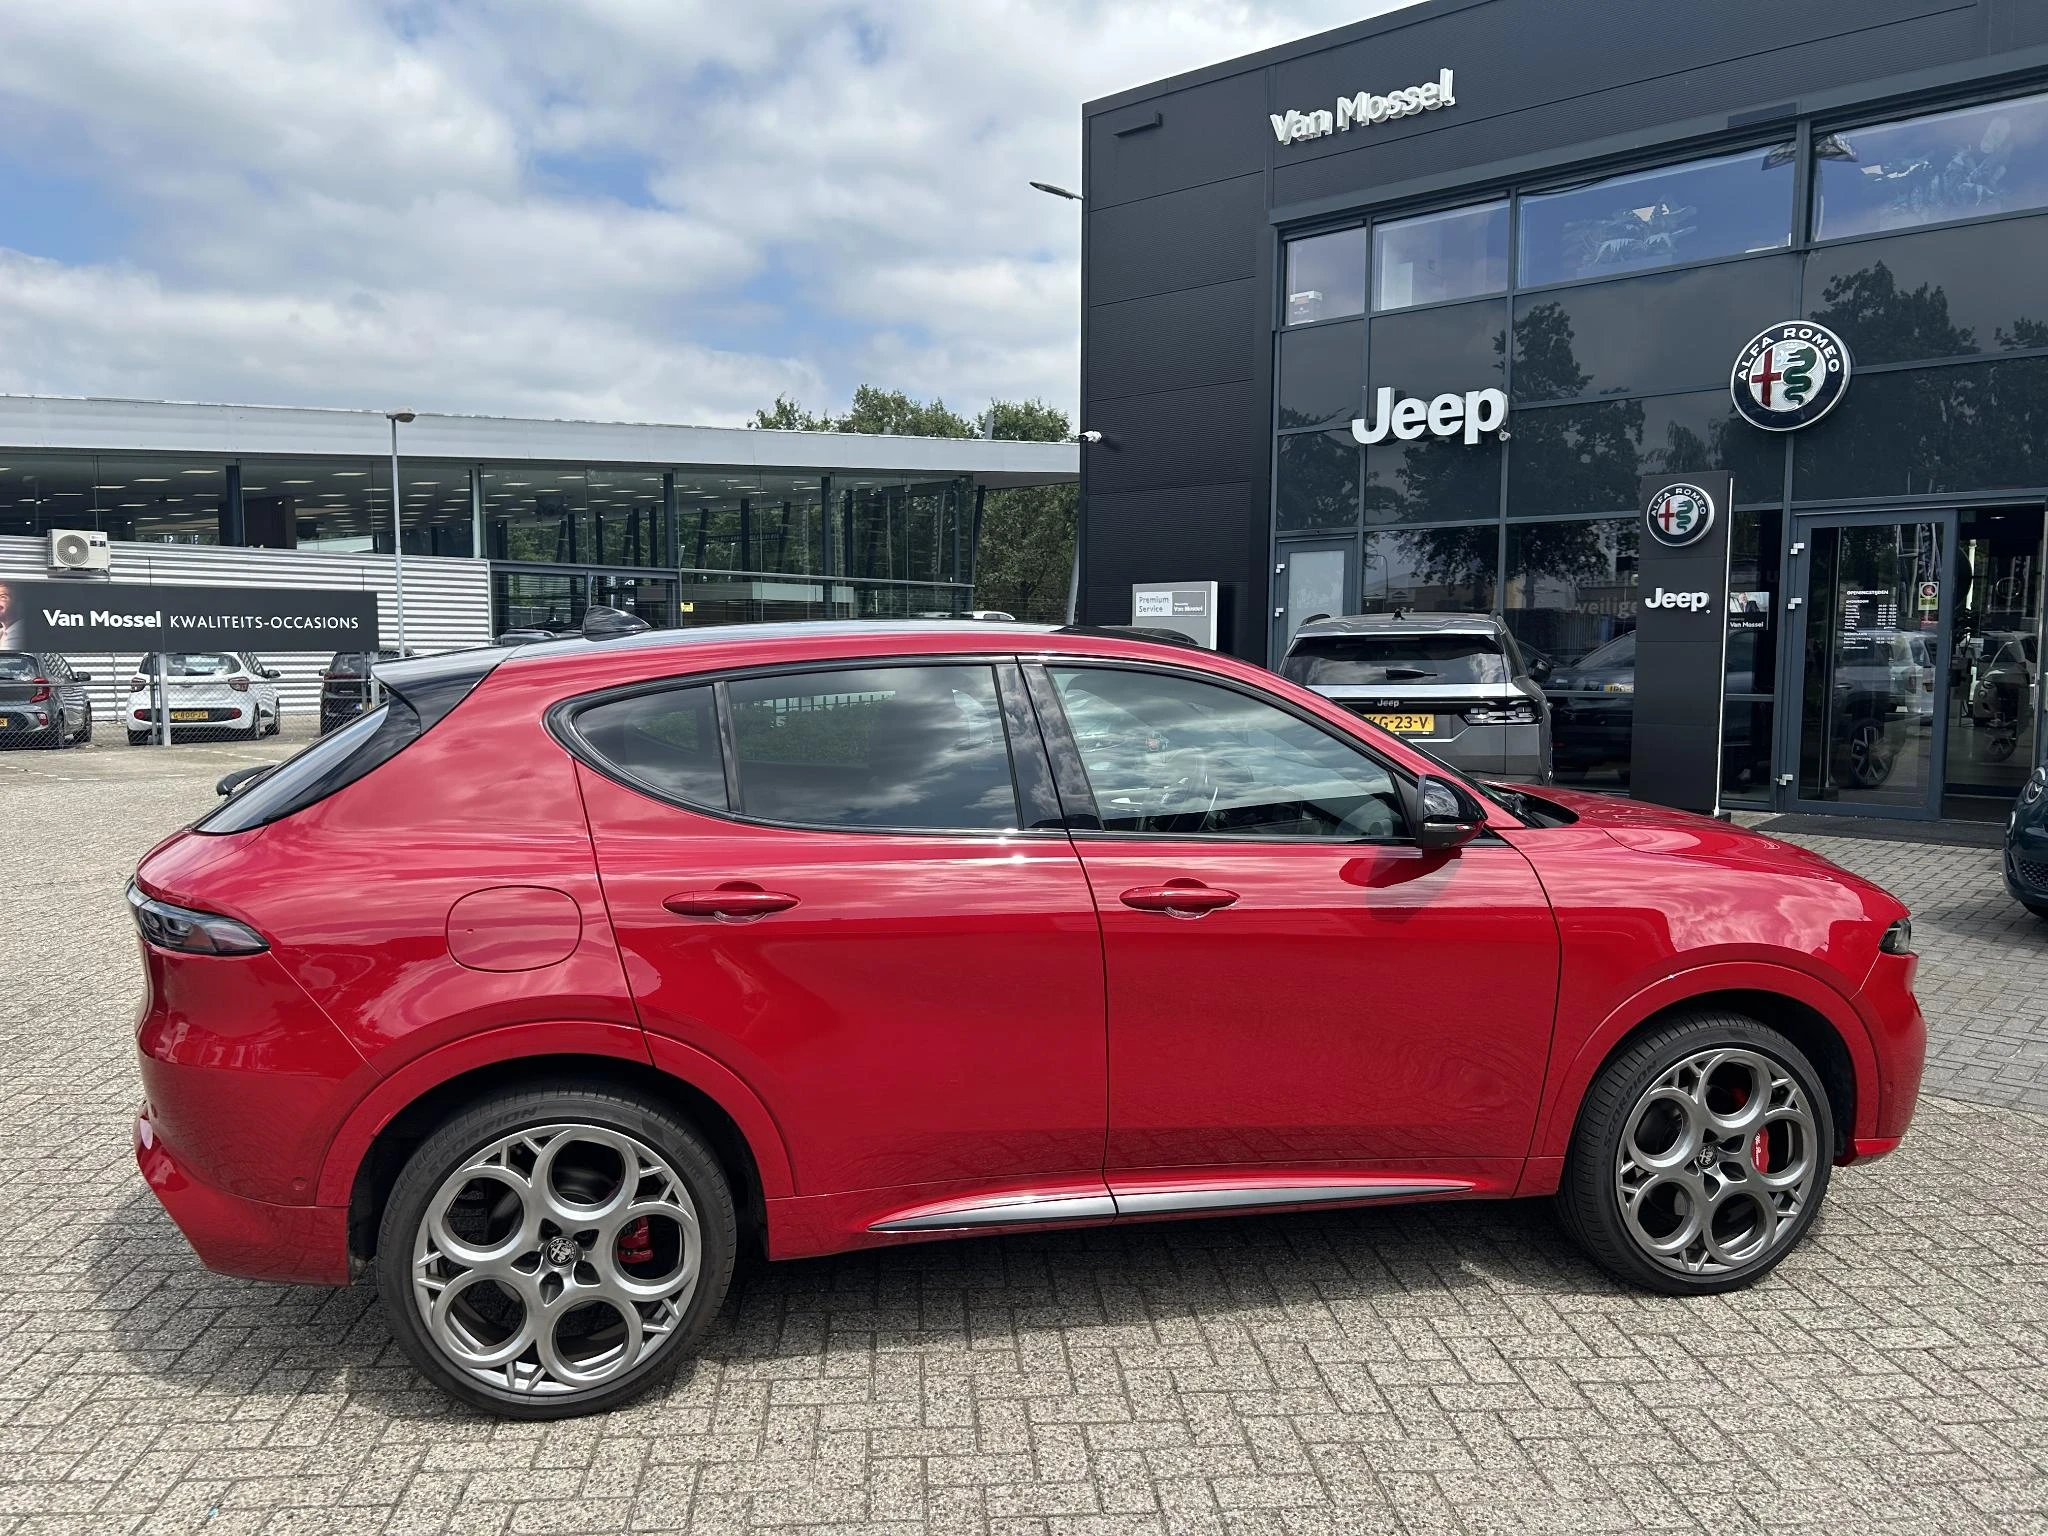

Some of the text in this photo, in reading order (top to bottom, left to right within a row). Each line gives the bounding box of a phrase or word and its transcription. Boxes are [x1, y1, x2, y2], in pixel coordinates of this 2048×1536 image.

[1270, 67, 1456, 145] Van Mossel
[1738, 327, 1840, 381] ALFA ROMEO
[1351, 386, 1509, 445] Jeep
[1651, 488, 1706, 516] ALFA ROMEO
[1138, 596, 1169, 604] Premium
[1138, 605, 1163, 613] Service
[1644, 587, 1709, 612] Jeep
[43, 609, 359, 630] Van Mossel KWALITEITS-OCCASIONS
[1377, 698, 1400, 708] Jeep
[1603, 1060, 1657, 1150] SCORPION
[426, 1105, 538, 1178] SCORPION
